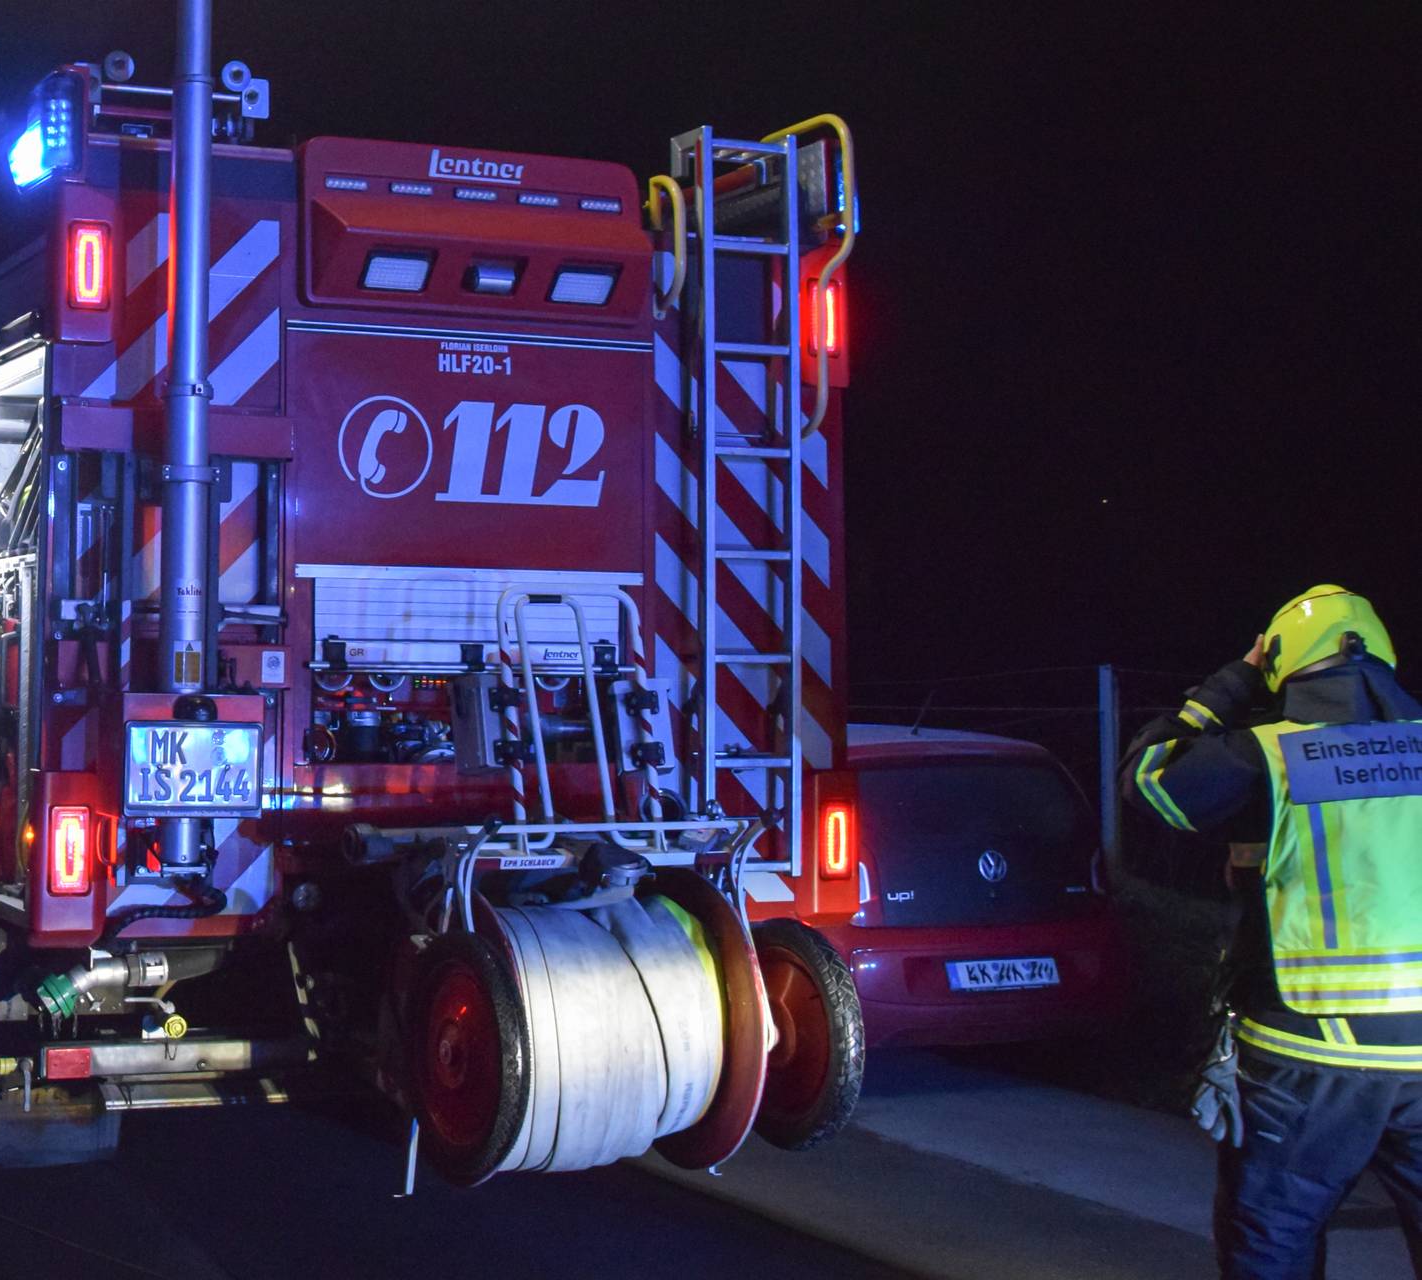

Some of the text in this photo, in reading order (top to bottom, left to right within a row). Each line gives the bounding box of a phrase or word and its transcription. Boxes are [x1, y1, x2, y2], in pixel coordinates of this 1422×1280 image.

[428, 148, 524, 184] Lentner
[440, 341, 509, 353] FLORIAN ISERLOHN
[438, 353, 512, 375] HLF20-1
[435, 401, 606, 507] 112
[151, 730, 188, 765] MK
[1302, 735, 1422, 761] Einsatzleit
[138, 767, 250, 802] IS 2144
[887, 890, 914, 902] up!
